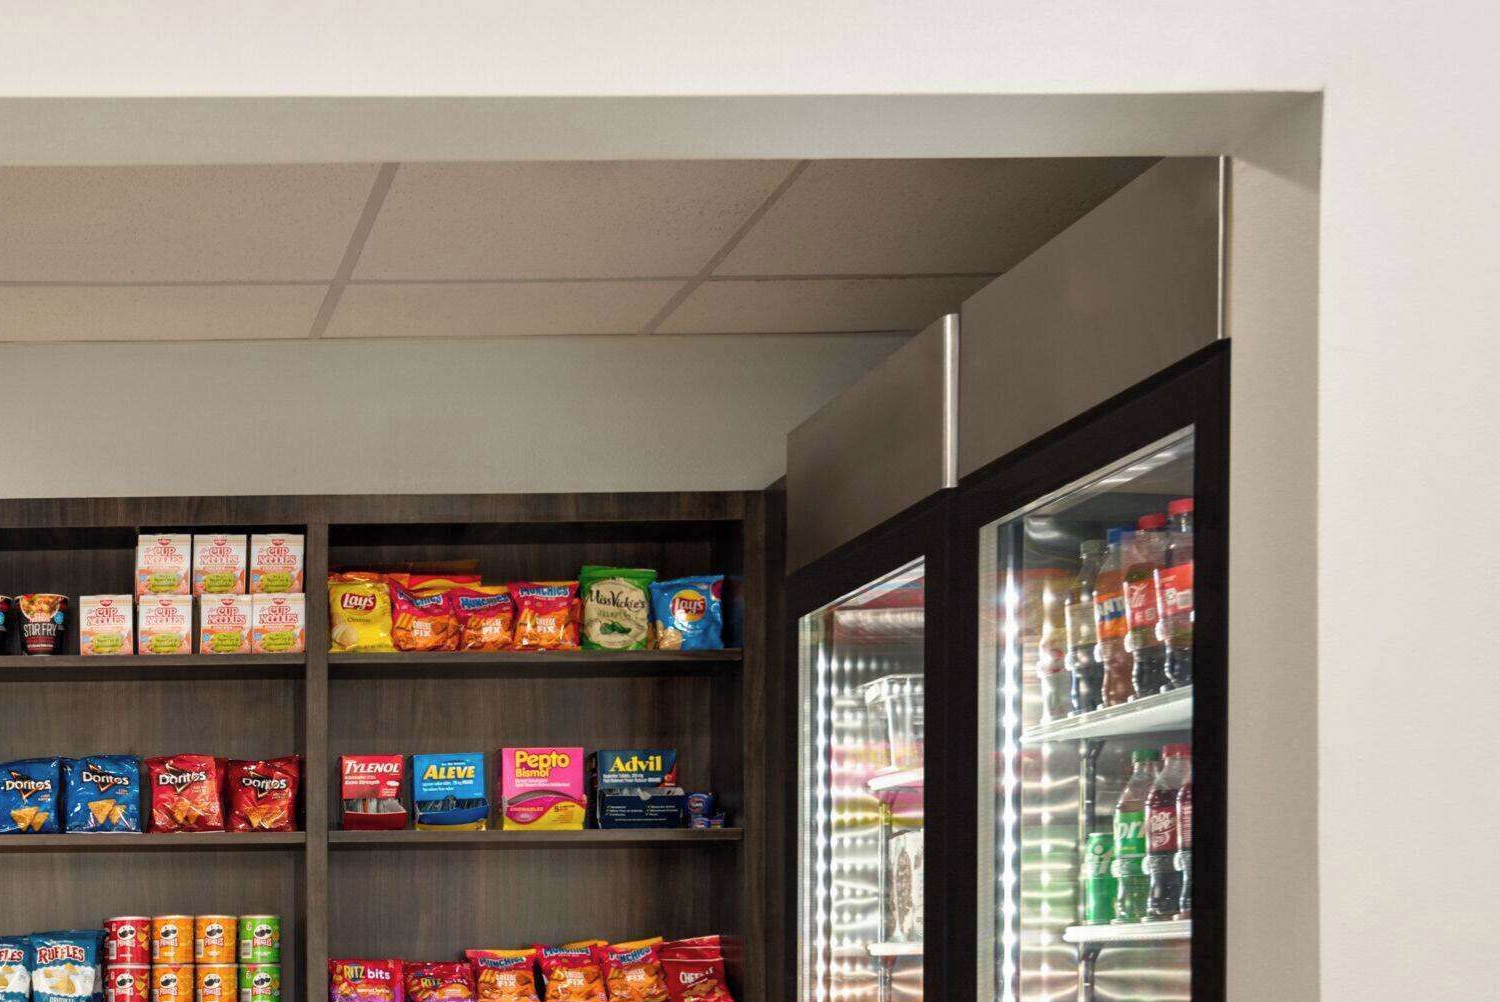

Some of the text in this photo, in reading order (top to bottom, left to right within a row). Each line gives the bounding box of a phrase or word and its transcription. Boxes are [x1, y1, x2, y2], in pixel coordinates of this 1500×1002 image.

[154, 547, 176, 557] CUP
[209, 547, 231, 557] CUP
[268, 547, 289, 557] CUP
[145, 555, 183, 565] NOODLES
[200, 555, 238, 565] NOODLES
[257, 555, 296, 565] NOODLES
[341, 592, 376, 609] Lay's
[95, 607, 118, 617] CUP
[154, 607, 177, 617] CUP
[216, 607, 238, 616] CUP
[268, 606, 290, 616] CUP
[87, 615, 125, 626] NOODLES
[145, 615, 184, 626] NOODLES
[207, 615, 246, 625] NOODLES
[259, 614, 298, 624] NOODLES
[42, 624, 57, 638] FRY
[515, 749, 571, 769] Pepto
[609, 755, 662, 772] Advil
[345, 760, 401, 775] TYLENOL
[423, 765, 476, 780] ALEVE
[515, 767, 550, 778] Bismol
[82, 771, 129, 786] Doritos
[158, 771, 207, 785] Doritos
[241, 777, 288, 790] Doritos
[5, 779, 51, 791] Doritos
[37, 945, 86, 964] RUFFLES
[343, 965, 391, 980] RITZ bits
